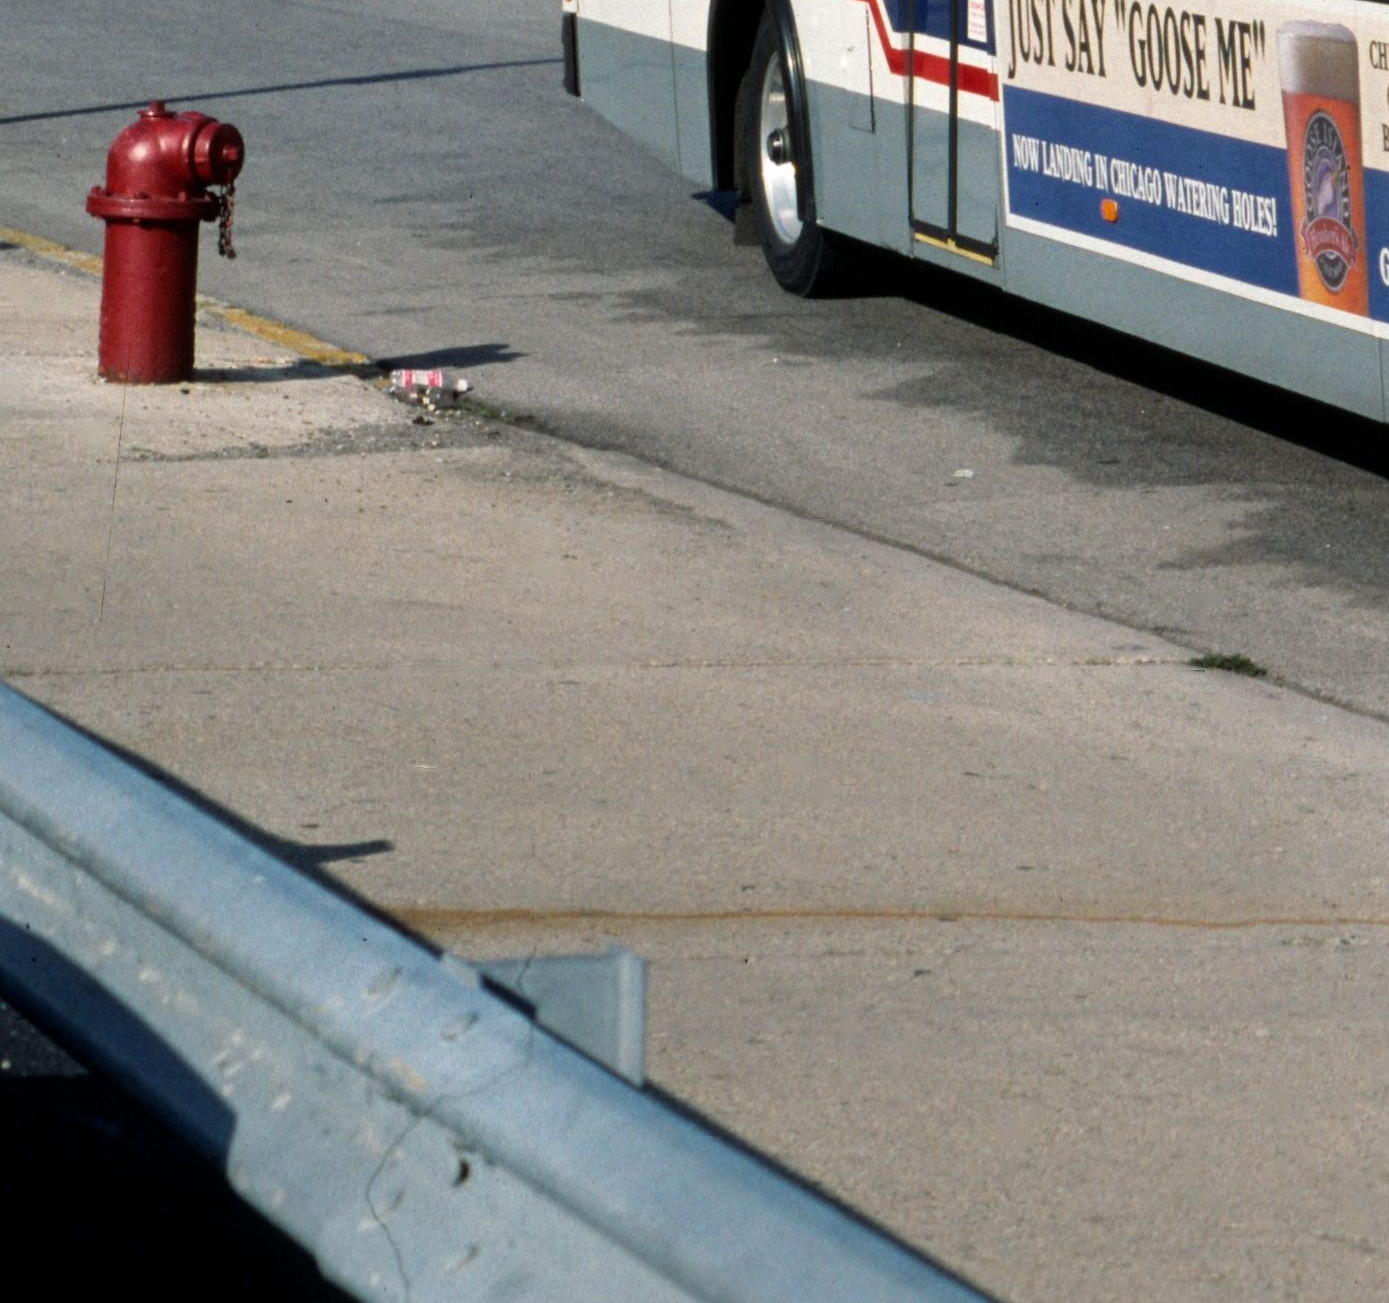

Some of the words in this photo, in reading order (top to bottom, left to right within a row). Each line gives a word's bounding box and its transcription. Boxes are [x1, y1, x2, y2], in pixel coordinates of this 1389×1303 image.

[1215, 17, 1266, 111] ME"
[1013, 134, 1039, 173] NOW
[1043, 141, 1093, 188] LANDING
[1095, 154, 1109, 193] IN
[1110, 158, 1162, 206] CHICAGO
[1163, 172, 1229, 226] WATERING
[1232, 189, 1278, 237] HOLES!
